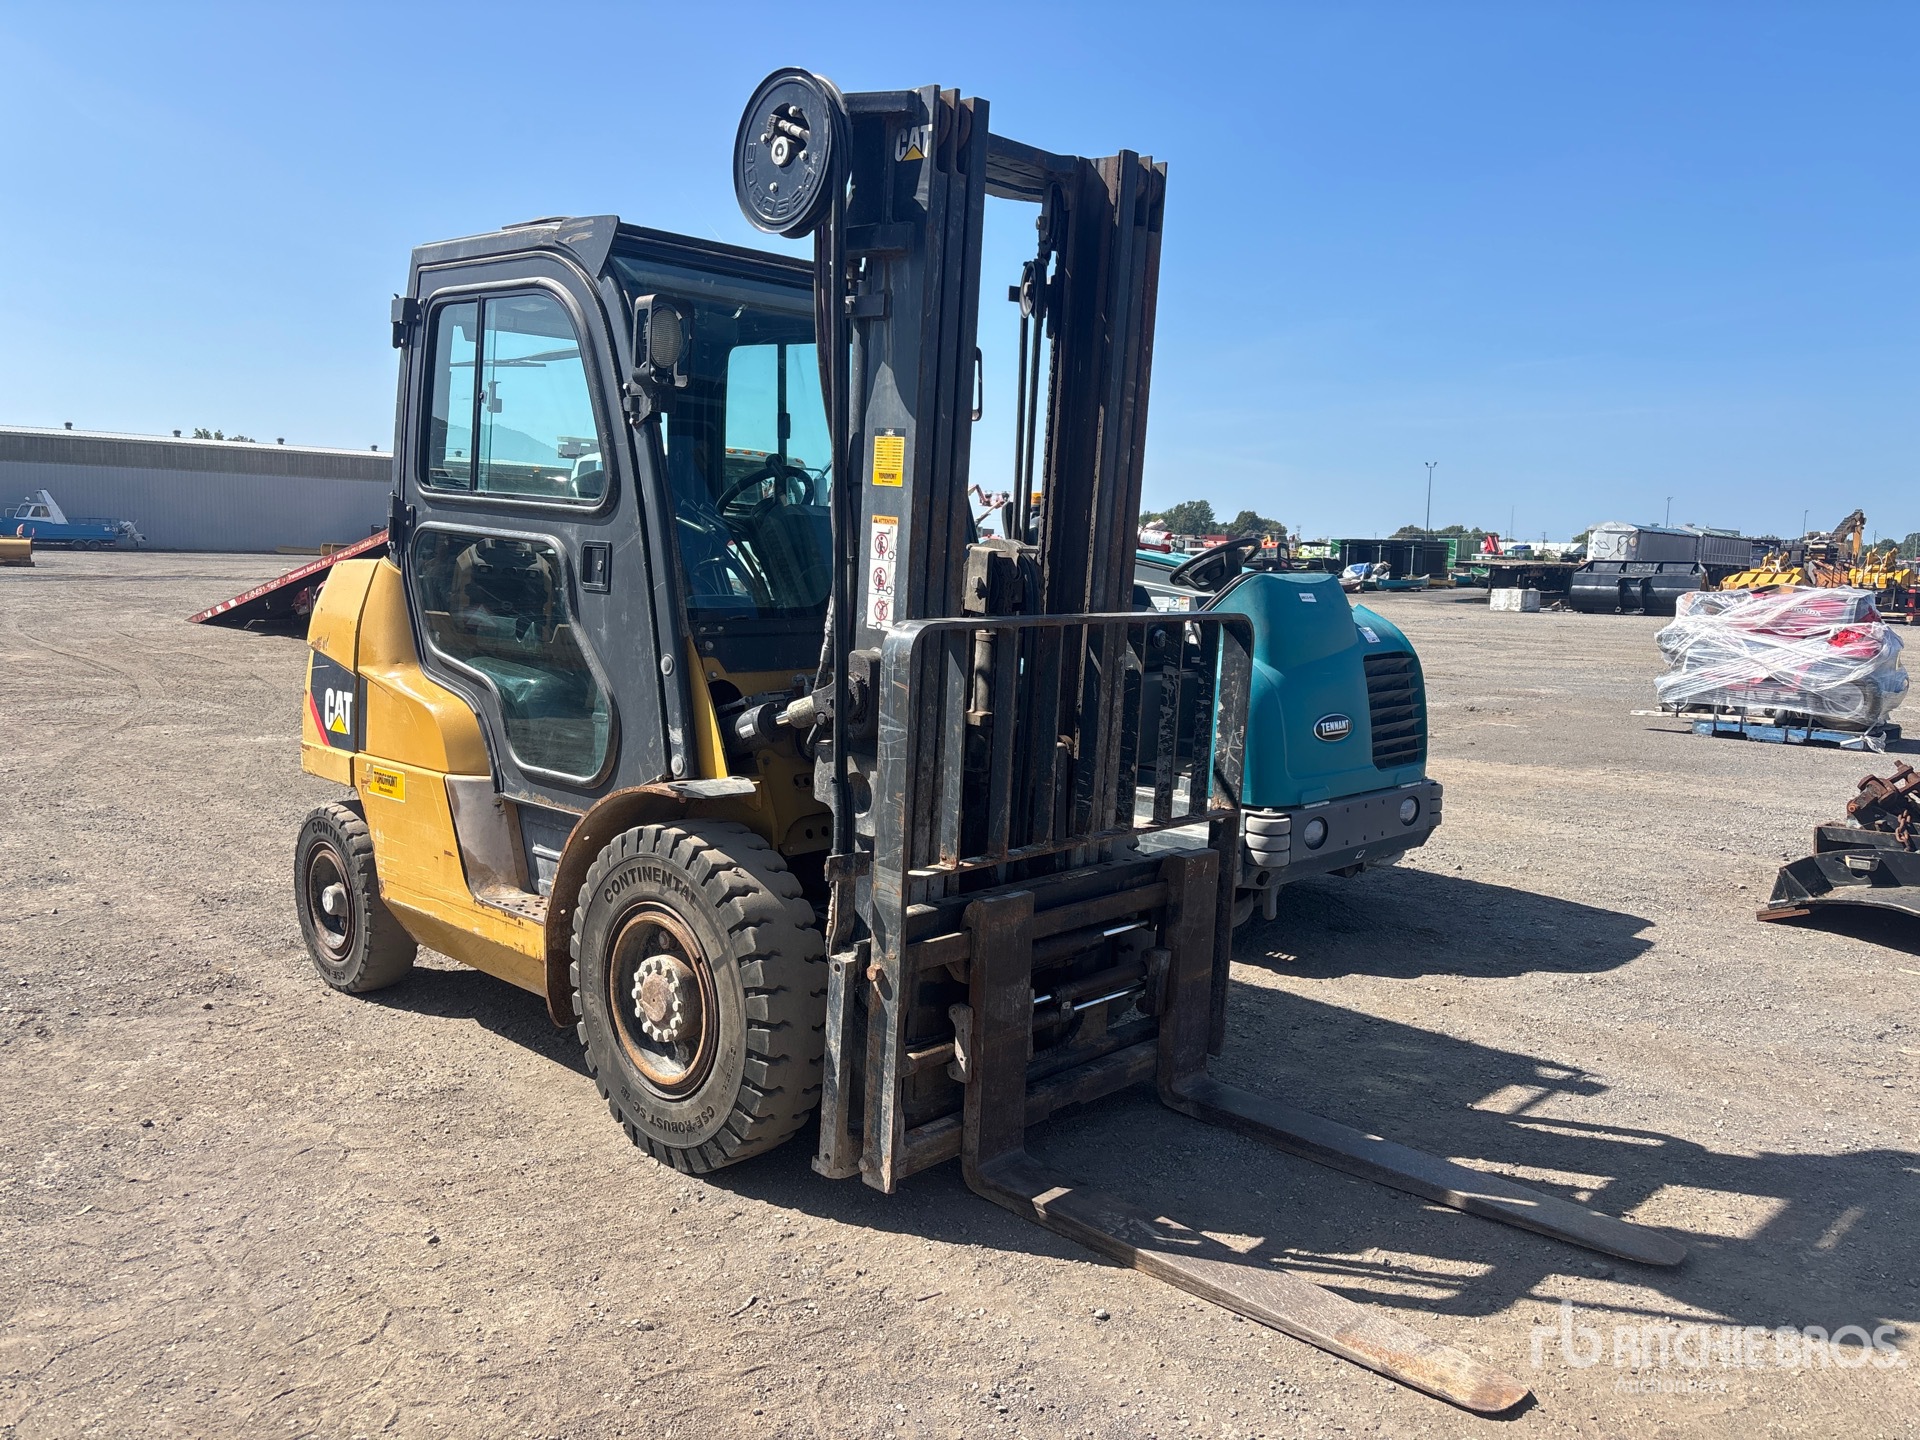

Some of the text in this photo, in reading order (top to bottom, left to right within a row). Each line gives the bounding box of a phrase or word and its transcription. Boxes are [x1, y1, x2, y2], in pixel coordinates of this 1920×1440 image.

[896, 124, 932, 161] CAT
[324, 687, 353, 736] CAT
[1321, 722, 1349, 733] TENNANT
[604, 866, 697, 911] CONTINENTAL
